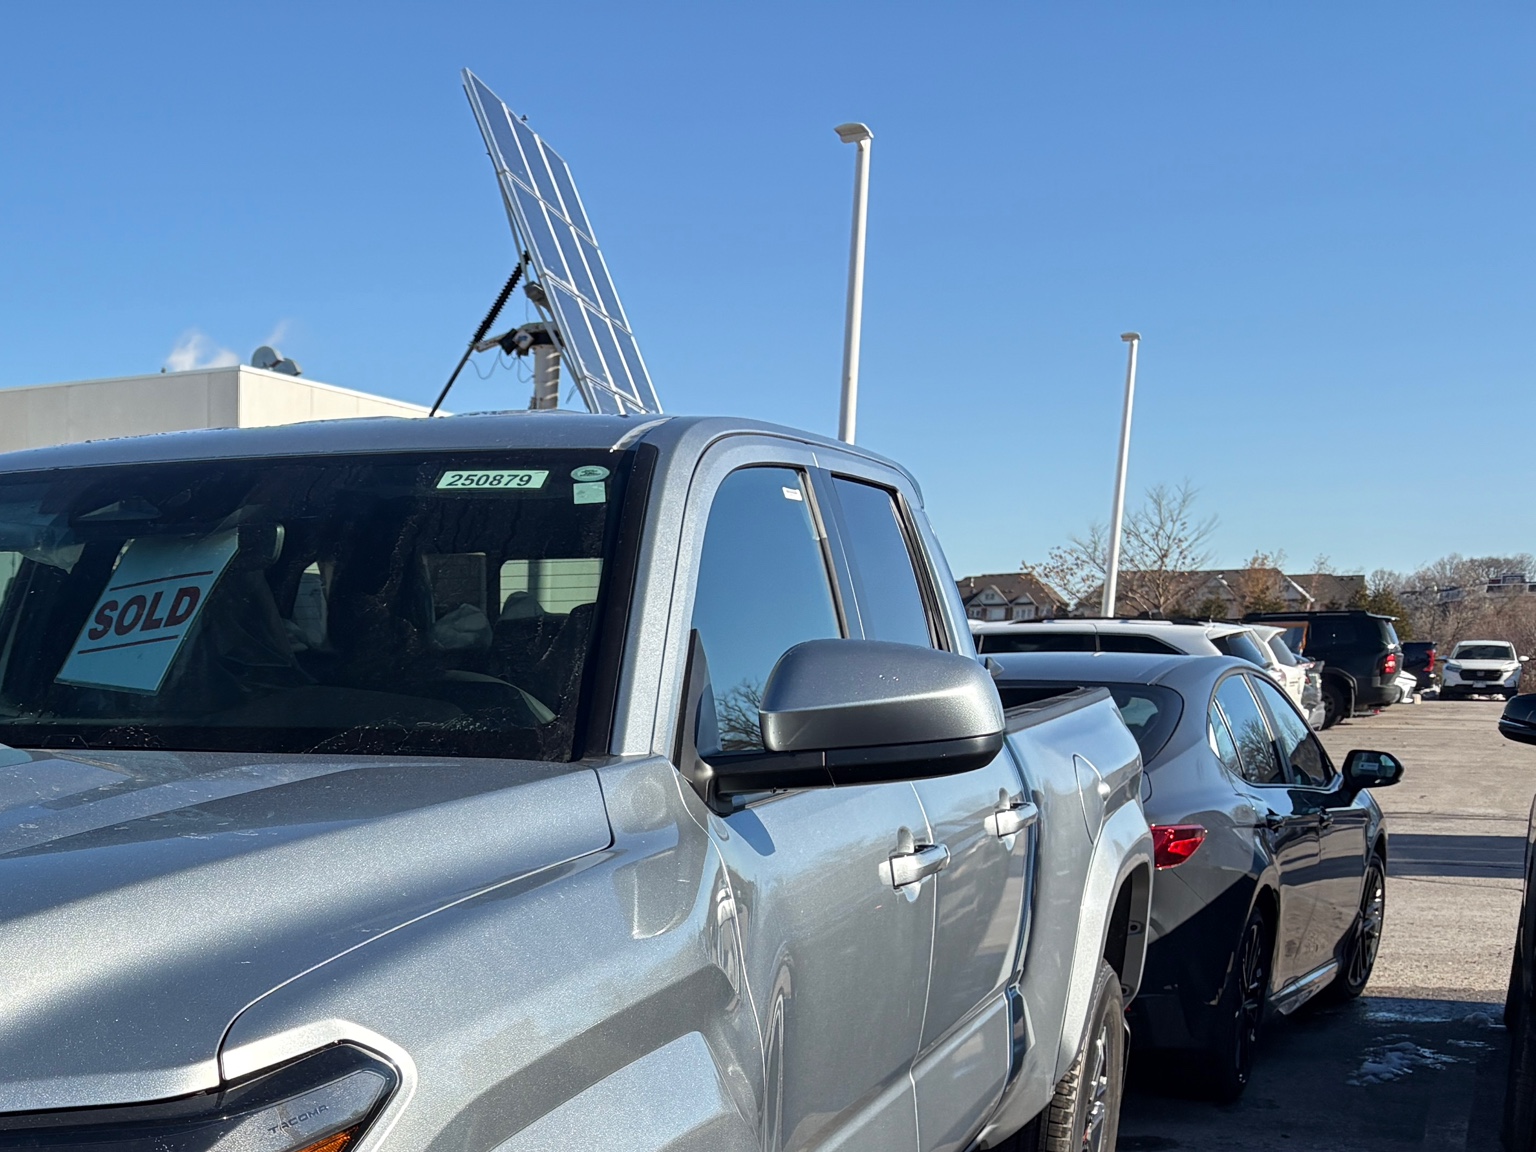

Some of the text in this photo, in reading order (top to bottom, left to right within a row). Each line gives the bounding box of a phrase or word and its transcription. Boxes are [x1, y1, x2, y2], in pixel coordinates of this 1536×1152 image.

[445, 473, 533, 487] 250879
[87, 585, 201, 641] SOLD
[267, 1104, 329, 1134] TACOMA
